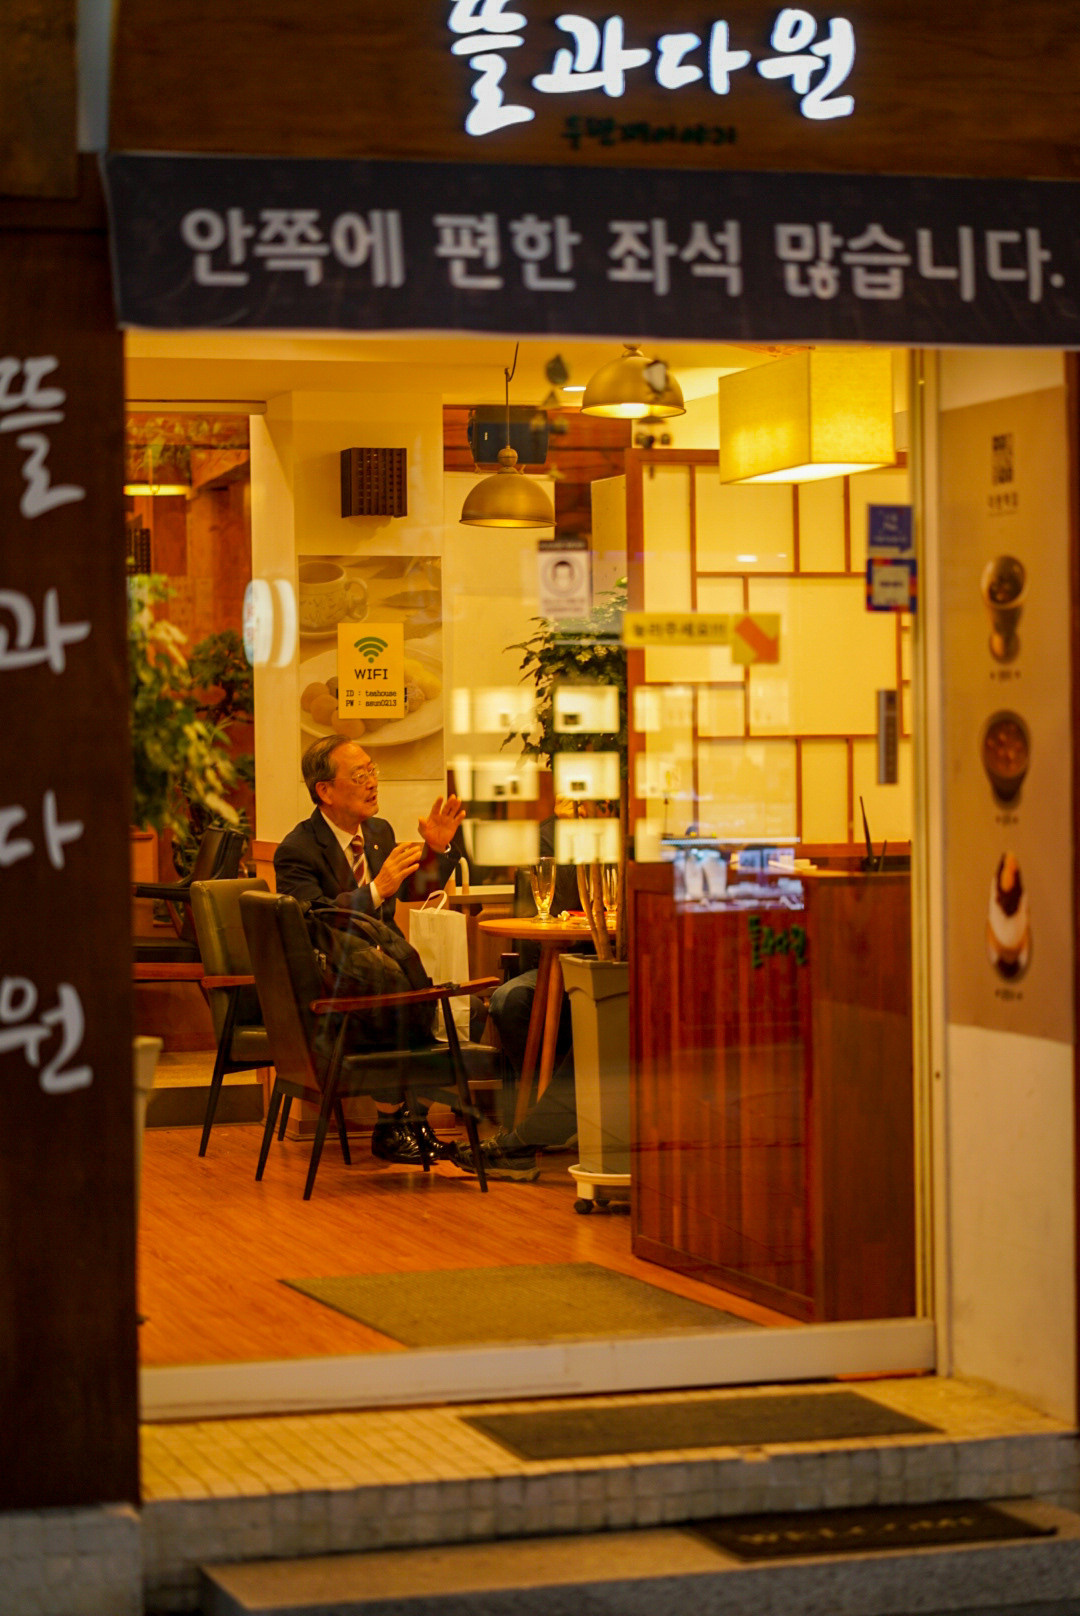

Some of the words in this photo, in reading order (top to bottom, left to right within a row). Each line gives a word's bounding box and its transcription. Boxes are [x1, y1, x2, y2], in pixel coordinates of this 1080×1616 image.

[448, 0, 856, 137] 뜰과다원
[181, 207, 405, 288] 안쪽에
[433, 212, 582, 292] 편한
[606, 217, 743, 297] 좌석
[774, 221, 1066, 304] 많습니다.
[346, 689, 354, 697] ID
[365, 689, 397, 697] teahouse
[354, 668, 388, 680] WIFI
